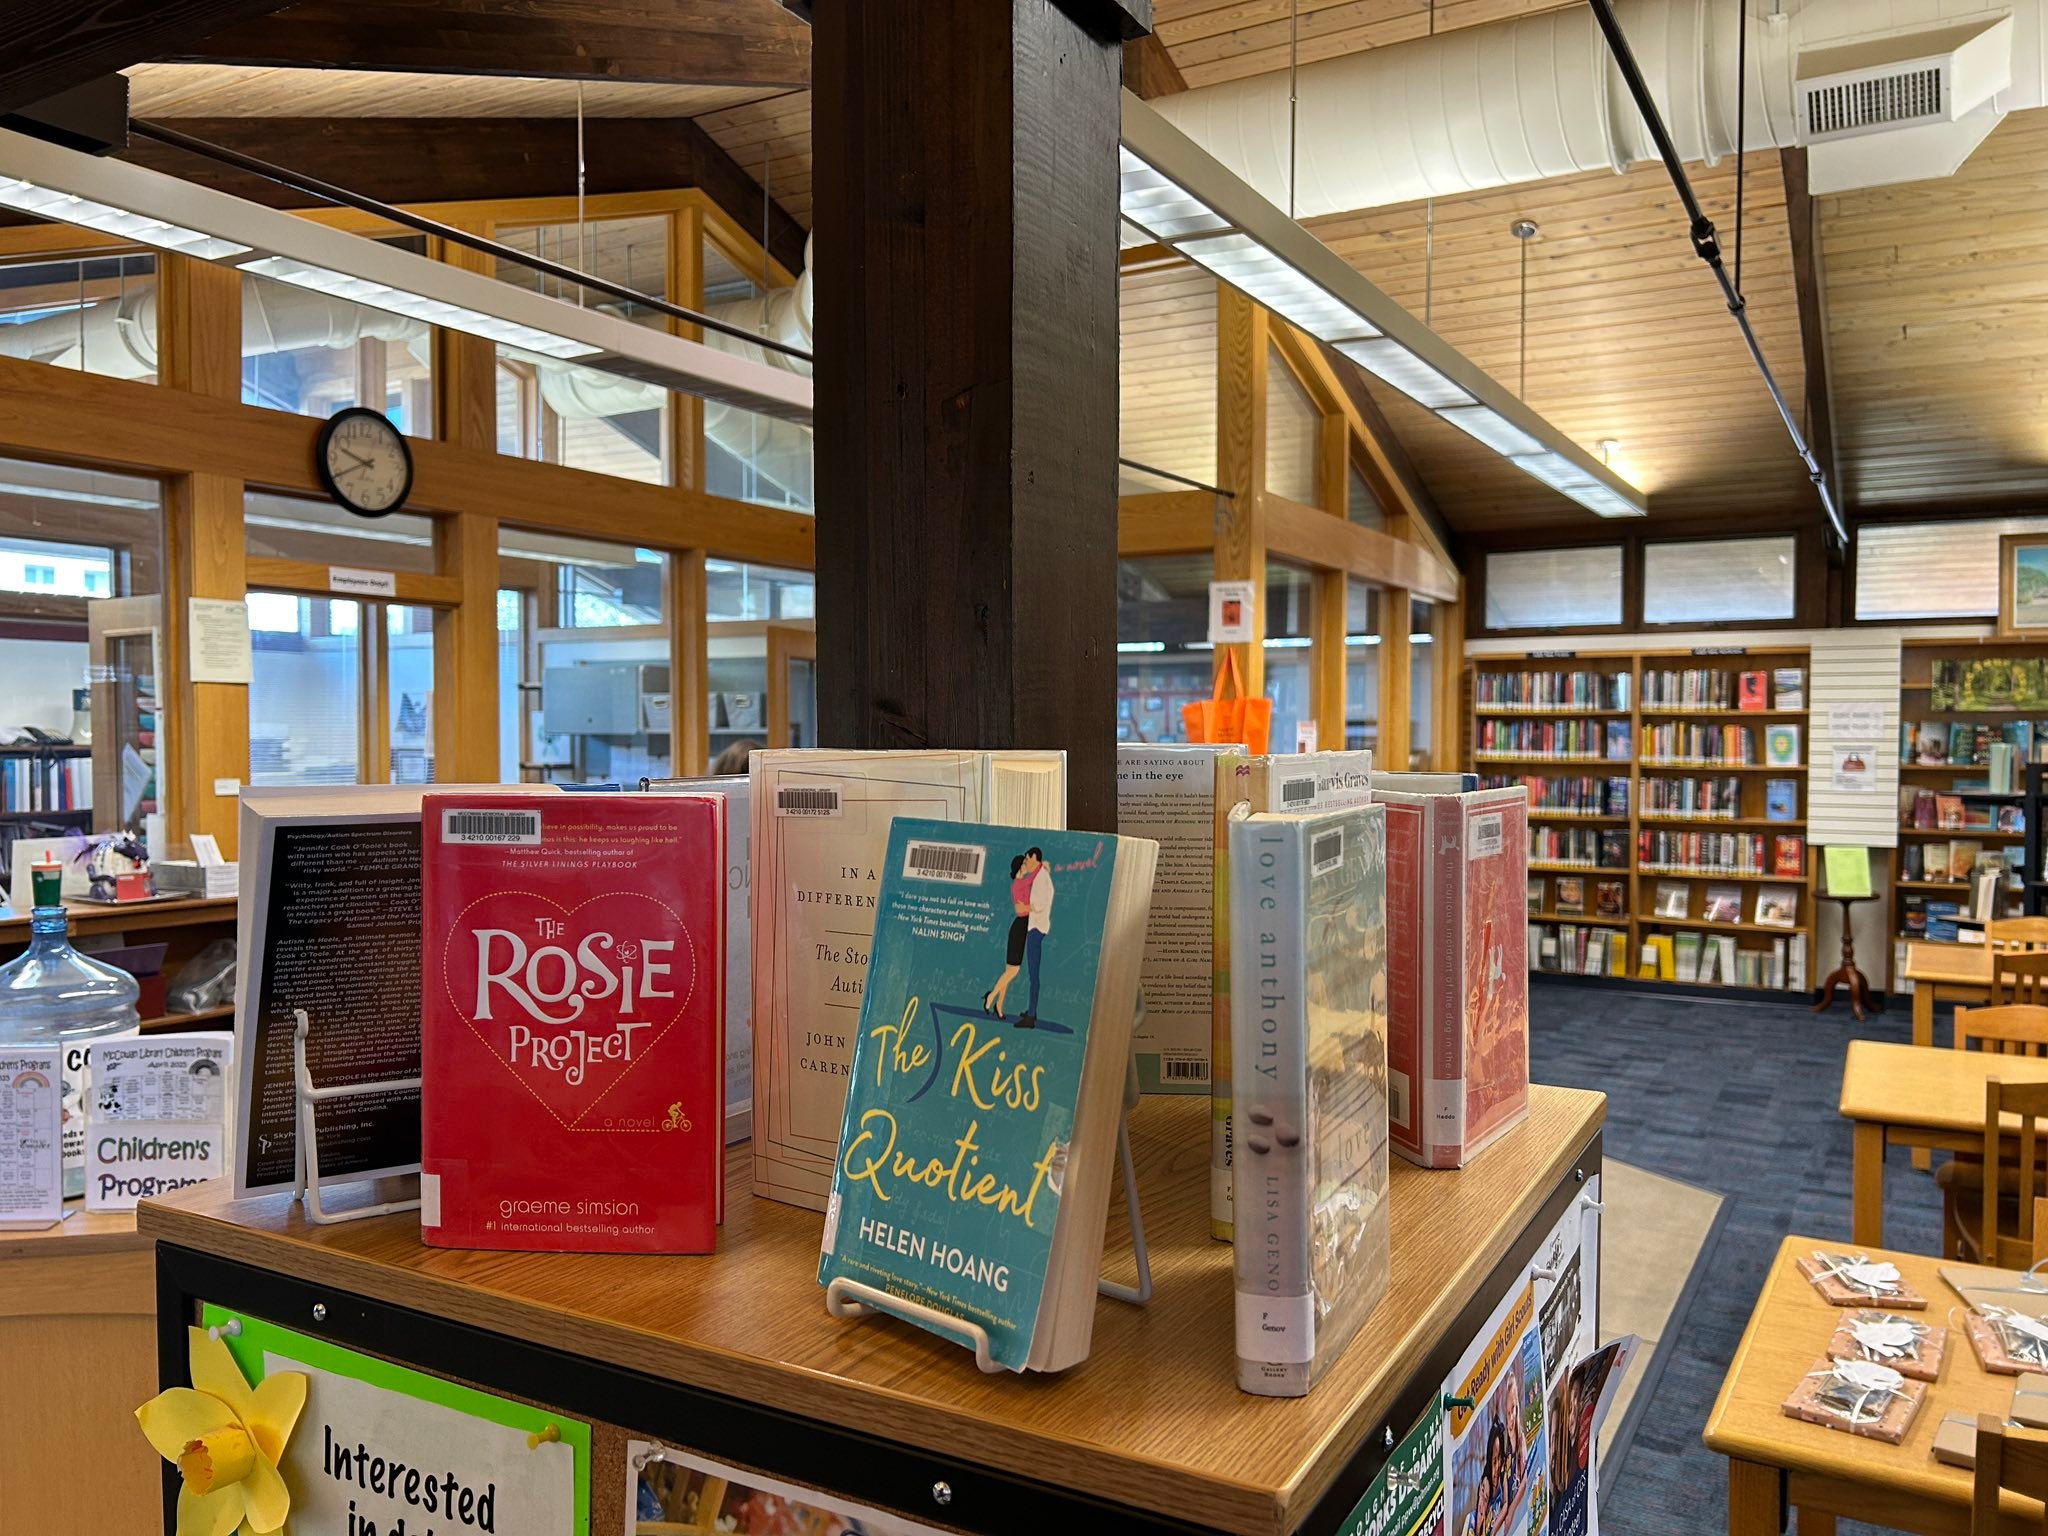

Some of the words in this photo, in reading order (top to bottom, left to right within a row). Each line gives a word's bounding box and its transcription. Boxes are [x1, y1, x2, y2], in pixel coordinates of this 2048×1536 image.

[1132, 771, 1142, 780] in
[1146, 771, 1162, 780] the
[1166, 773, 1183, 781] eye
[1344, 772, 1369, 788] Graves
[638, 824, 658, 832] proud
[620, 836, 649, 845] laughing
[367, 850, 396, 858] aspects
[564, 849, 601, 857] bestselling
[1067, 841, 1104, 870] novel
[501, 860, 517, 868] THE
[520, 860, 549, 868] SILVER
[1259, 836, 1284, 911] love
[1446, 862, 1455, 879] the
[841, 867, 859, 879] IN
[866, 868, 876, 881] A
[797, 890, 876, 908] DIFFEREN
[905, 892, 916, 900] dare
[918, 895, 928, 903] you
[947, 896, 957, 904] fall
[964, 899, 976, 907] love
[1446, 884, 1454, 926] curious
[919, 905, 947, 915] characters
[948, 908, 958, 917] and
[959, 909, 974, 919] their
[534, 917, 564, 939] THE
[910, 915, 922, 924] York
[923, 916, 938, 925] Times
[940, 919, 969, 932] bestselling
[912, 927, 938, 938] NALINI
[940, 931, 965, 942] SINGH
[816, 943, 841, 963] The
[844, 946, 868, 966] Sto
[1446, 928, 1454, 971] incident
[830, 975, 864, 994] Auti
[1446, 973, 1453, 986] of
[1255, 931, 1286, 1081] anthony
[1446, 989, 1454, 1009] the
[1444, 1012, 1454, 1032] dog
[805, 1032, 845, 1048] JOHN
[1446, 1036, 1454, 1048] in
[509, 1022, 652, 1086] PROJECT
[870, 997, 931, 1087] The
[950, 1023, 1045, 1112] Kiss
[1446, 1052, 1454, 1068] the
[800, 1057, 850, 1076] CAREN
[604, 1118, 612, 1127] a
[618, 1116, 655, 1128] novel
[97, 1136, 211, 1164] Children's
[843, 1108, 1057, 1229] Quotient
[500, 1200, 570, 1218] graeme
[576, 1199, 638, 1216] simsion
[1266, 1175, 1279, 1223] LISA
[486, 1221, 496, 1231] #1
[501, 1222, 562, 1233] international
[566, 1222, 618, 1236] bestselling
[622, 1225, 655, 1235] author
[859, 1216, 927, 1258] HELEN
[930, 1240, 1010, 1293] HOANG
[1266, 1232, 1280, 1292] GENO
[870, 1265, 891, 1282] riveting
[891, 1272, 904, 1284] love
[938, 1290, 951, 1301] York
[951, 1294, 967, 1309] Times
[967, 1302, 999, 1324] bestselling
[998, 1317, 1017, 1330] author
[885, 1283, 925, 1305] PENELOPE
[1262, 1312, 1268, 1321] F
[1262, 1323, 1286, 1333] Genov
[1471, 1360, 1492, 1402] Ready
[1491, 1335, 1504, 1366] with
[1504, 1315, 1515, 1348] Girl
[1515, 1292, 1532, 1333] Scouts
[324, 1424, 495, 1534] Interested
[349, 1500, 376, 1536] in
